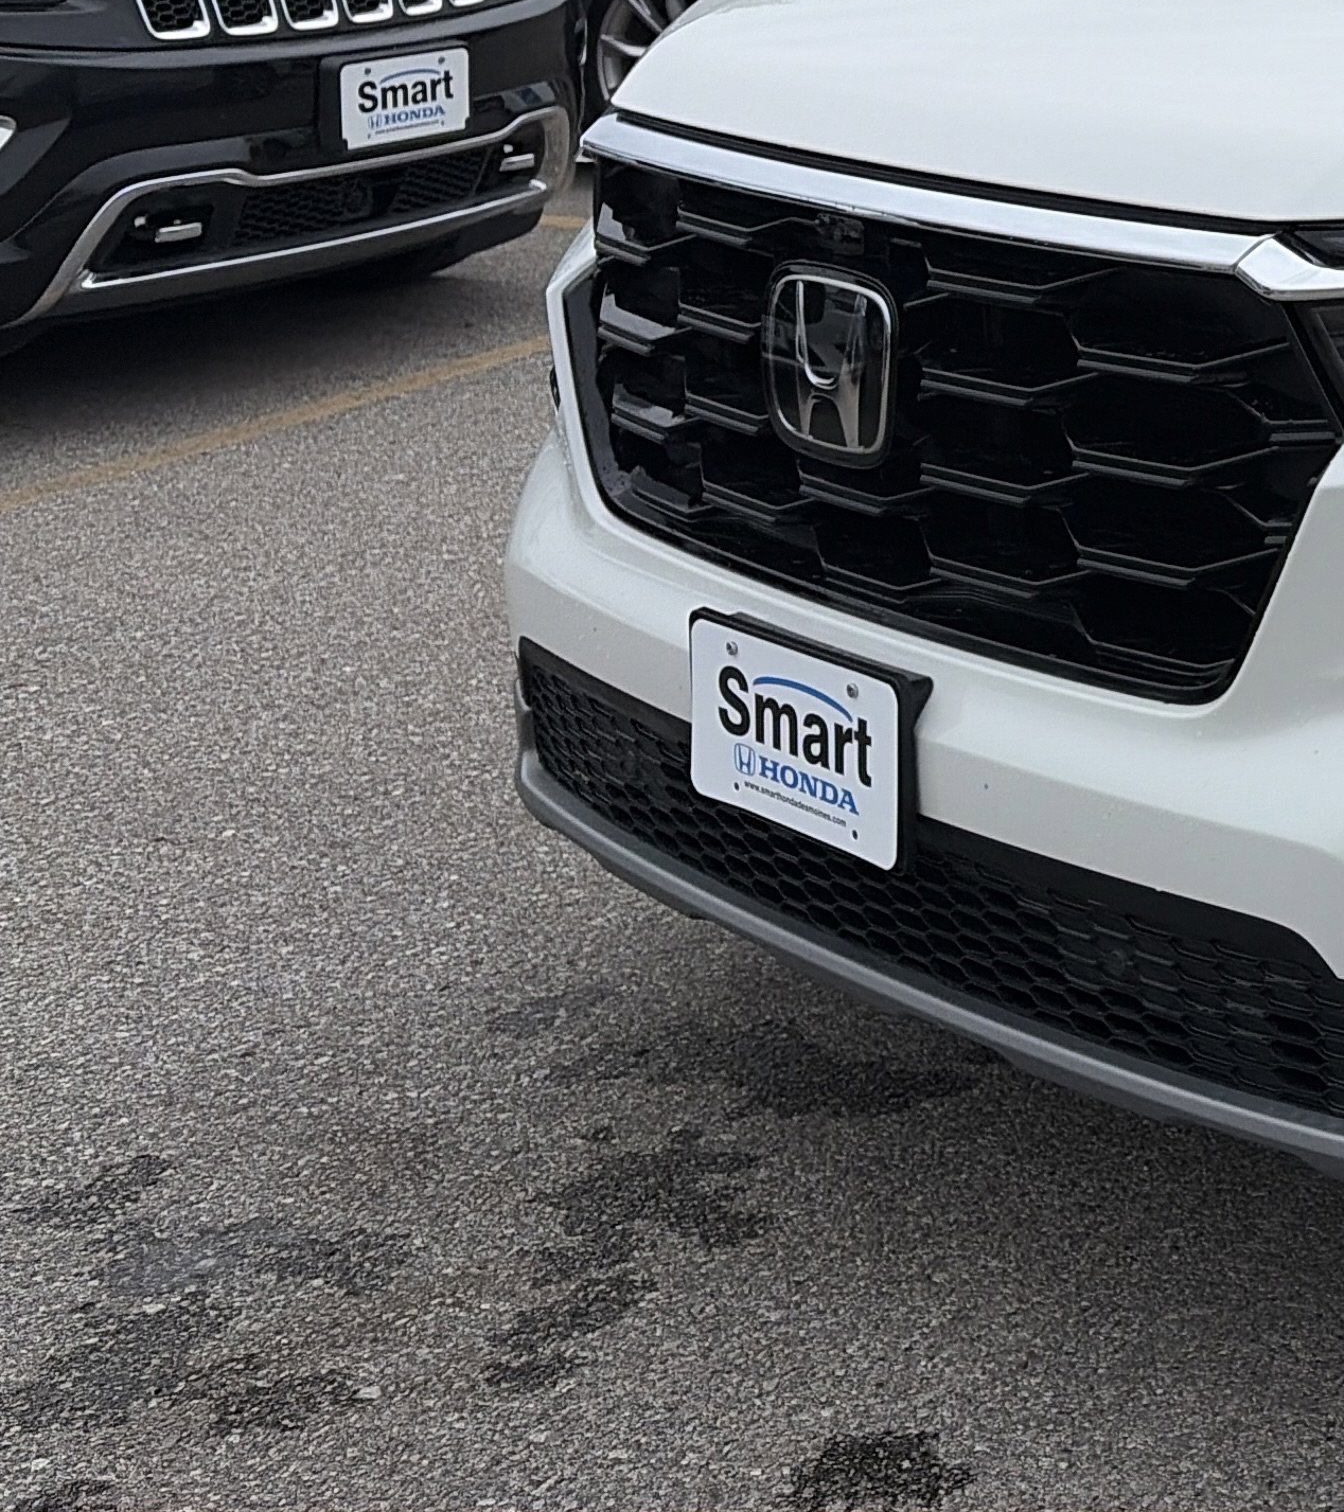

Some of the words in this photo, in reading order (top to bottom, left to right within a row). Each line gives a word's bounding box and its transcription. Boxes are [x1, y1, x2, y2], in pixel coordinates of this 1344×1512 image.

[358, 69, 454, 113] Smart
[384, 104, 446, 126] HONDA
[718, 665, 873, 788] Smart
[758, 754, 859, 816] HONDA
